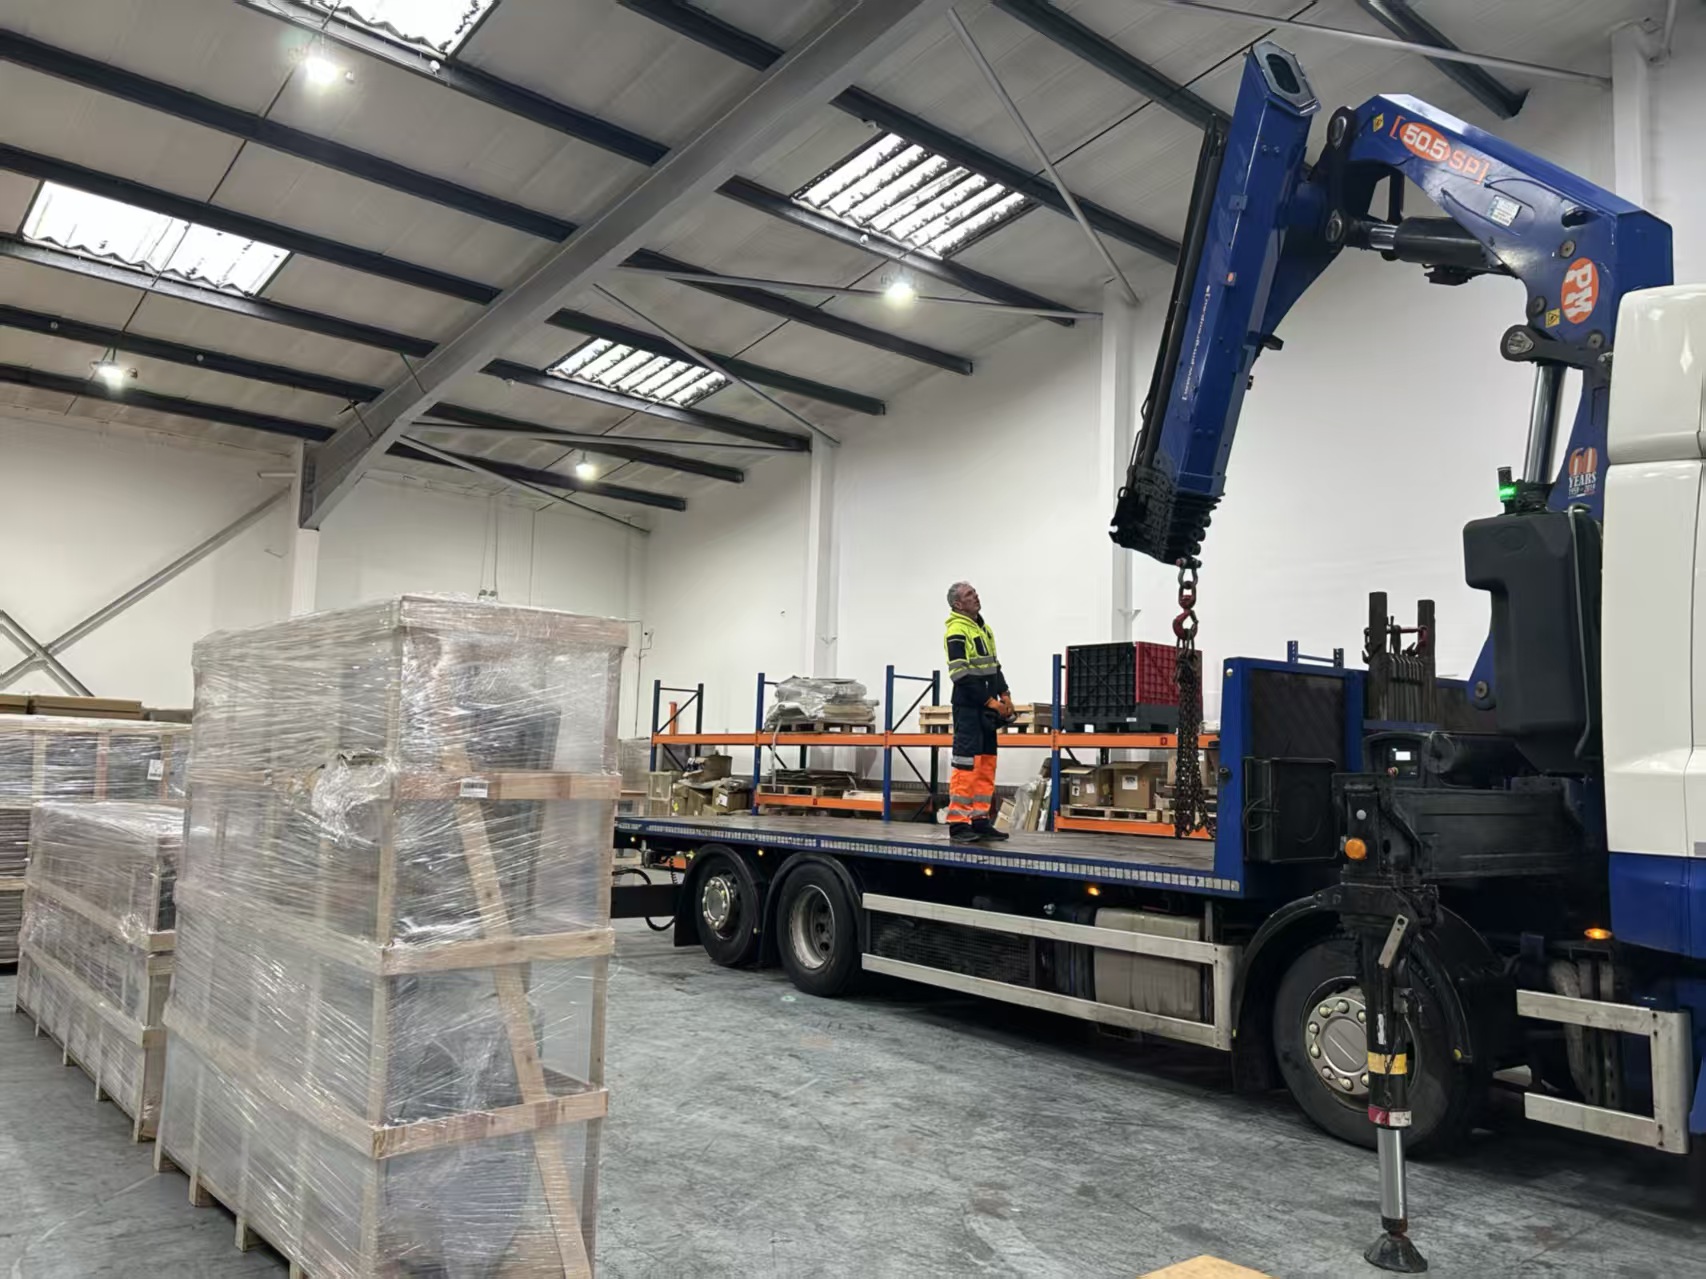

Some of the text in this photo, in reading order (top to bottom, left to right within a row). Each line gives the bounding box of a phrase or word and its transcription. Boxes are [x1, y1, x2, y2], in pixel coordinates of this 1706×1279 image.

[1564, 263, 1593, 319] PM
[1569, 447, 1597, 476] 60
[1569, 472, 1596, 488] YEARS
